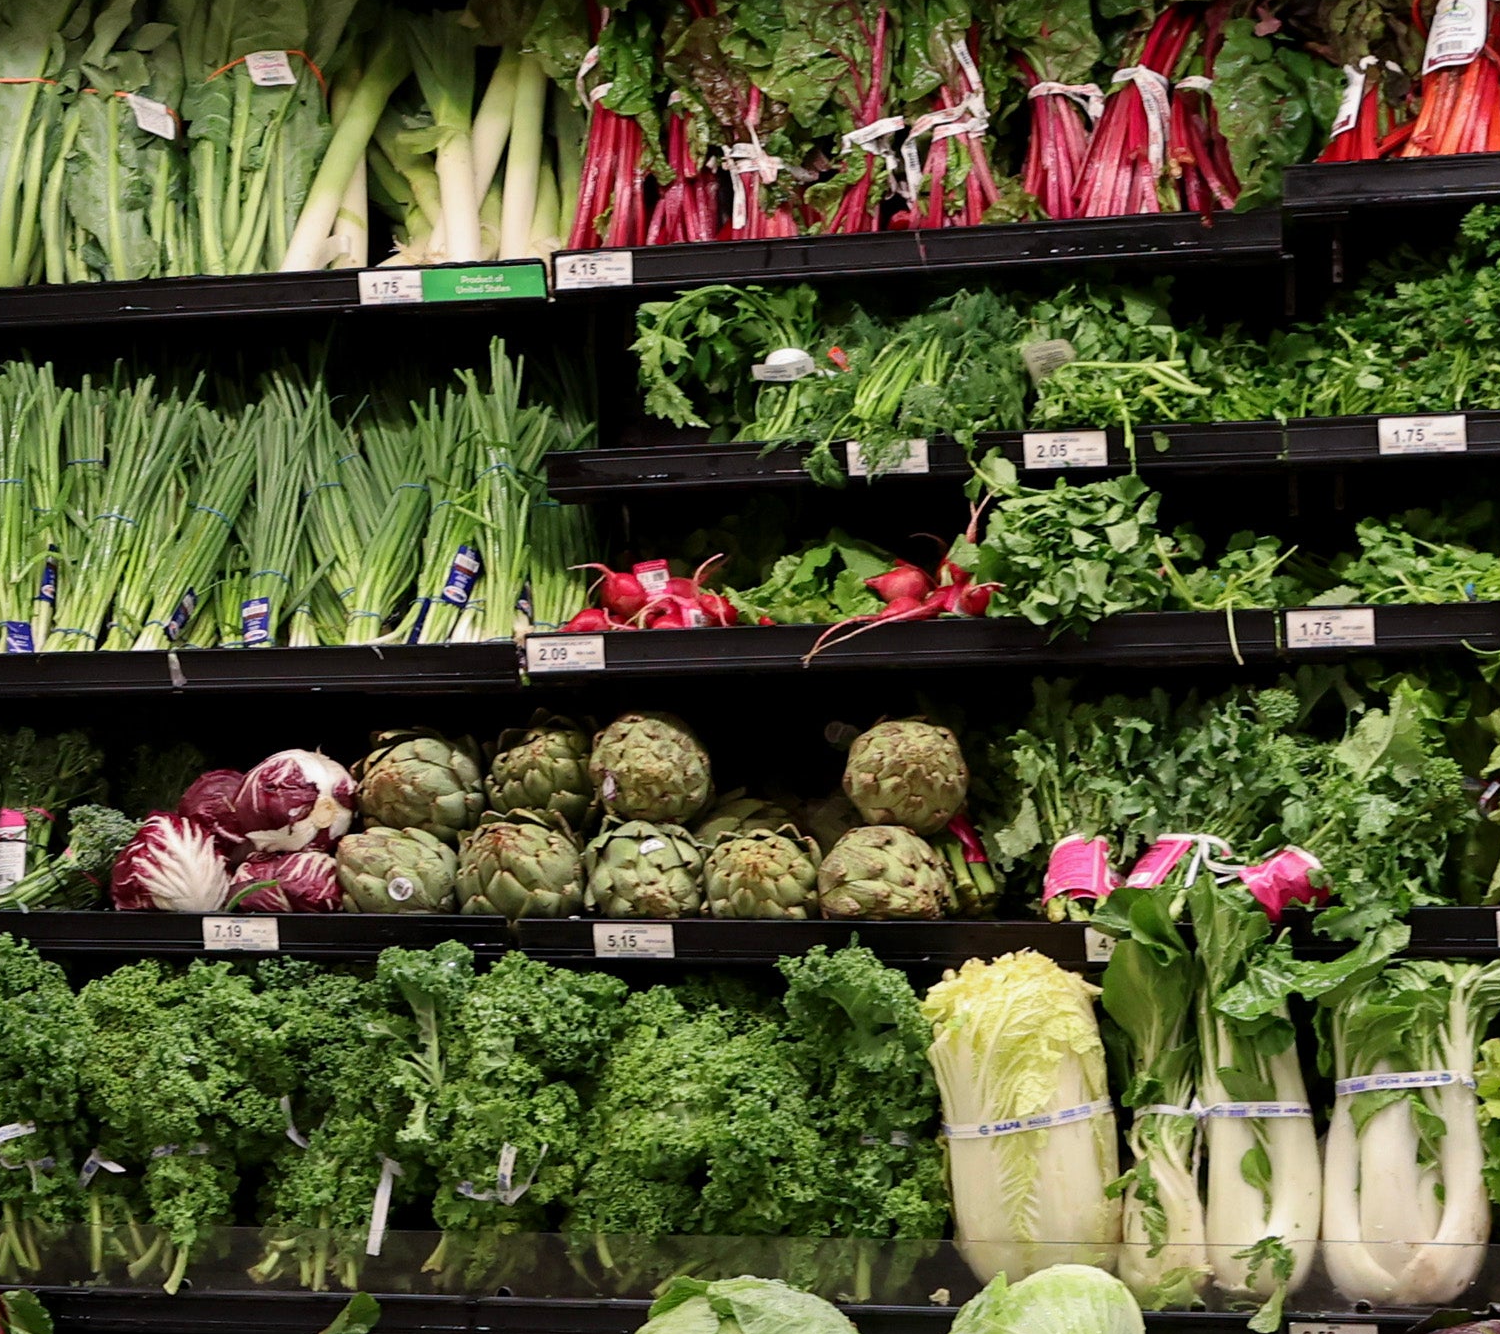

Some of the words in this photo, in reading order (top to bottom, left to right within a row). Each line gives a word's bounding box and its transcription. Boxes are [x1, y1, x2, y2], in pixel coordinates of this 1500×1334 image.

[568, 261, 599, 276] 4.15
[459, 273, 489, 284] Product
[491, 272, 504, 282] of
[370, 280, 399, 295] 1.75
[454, 284, 486, 295] United
[488, 283, 512, 293] States
[1393, 428, 1425, 443] 1.75
[1036, 443, 1068, 458] 2.05
[1300, 620, 1333, 636] 1.75
[539, 647, 568, 661] 2.09
[214, 925, 242, 938] 7.19
[607, 934, 638, 948] 5.15
